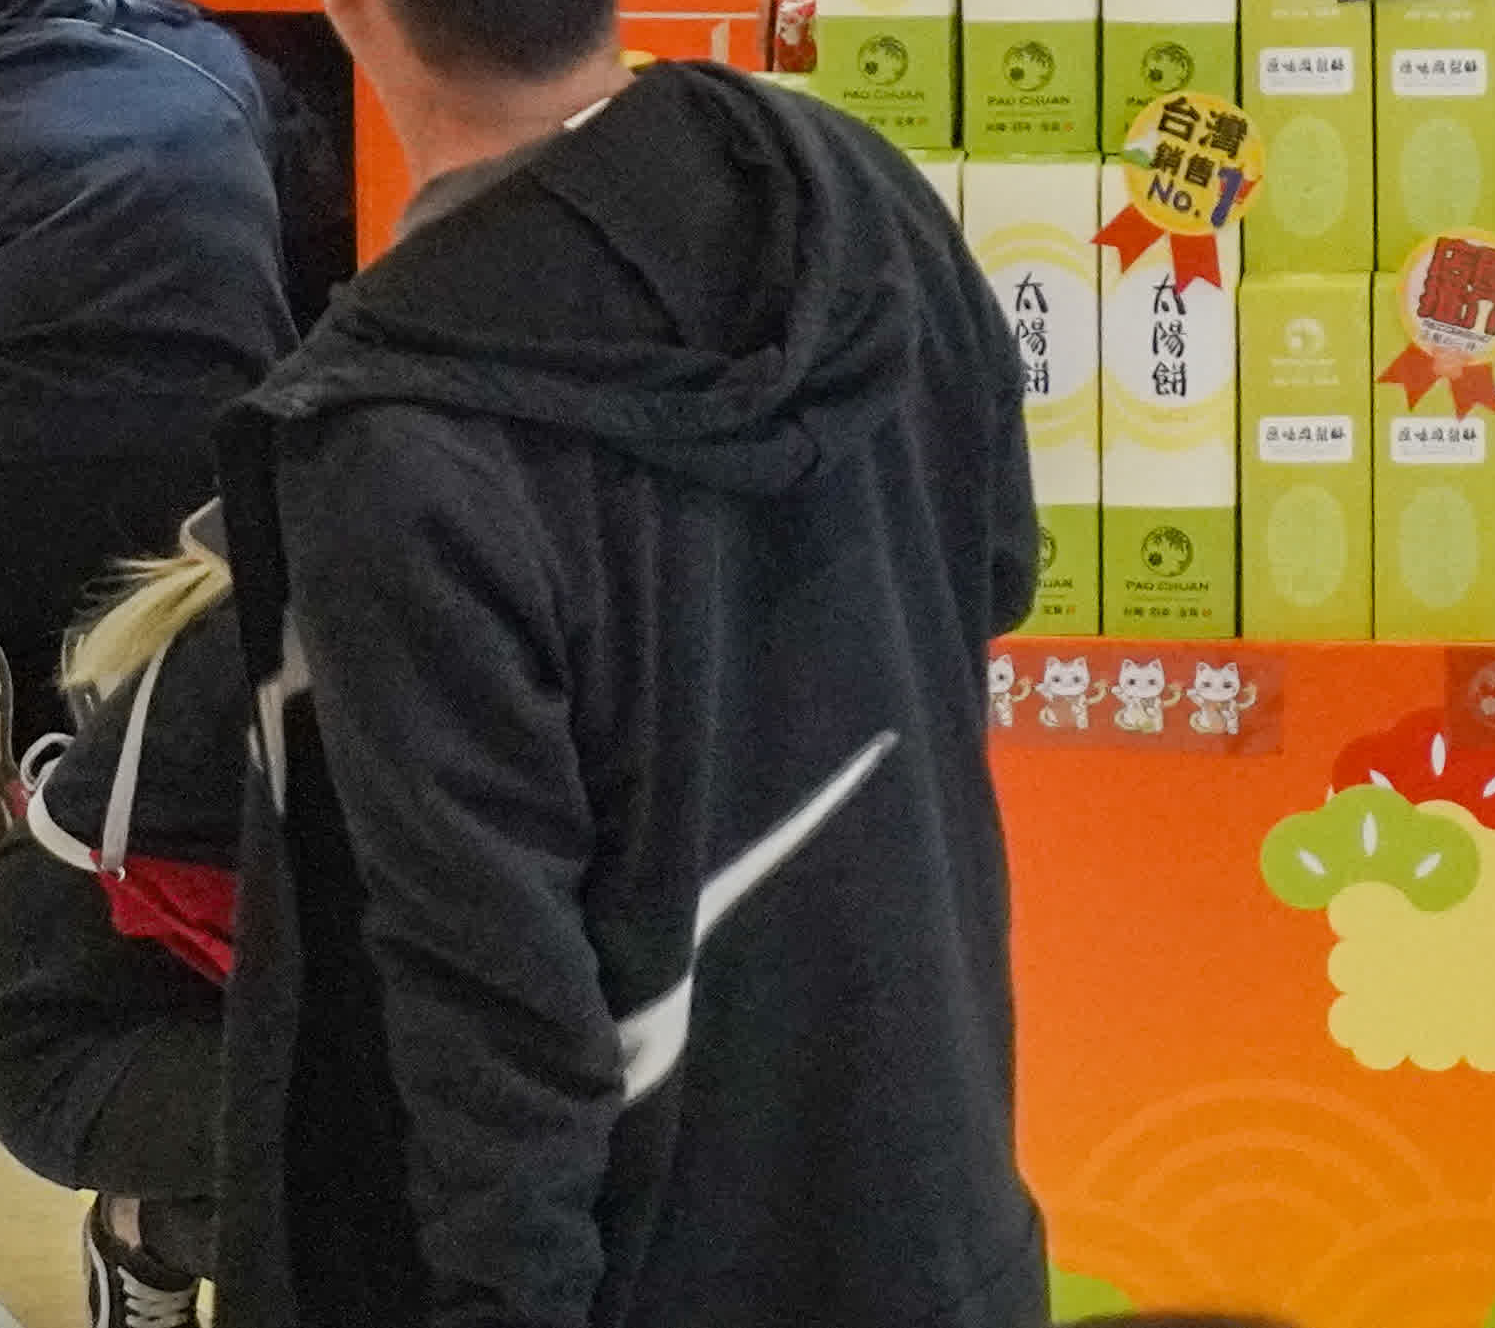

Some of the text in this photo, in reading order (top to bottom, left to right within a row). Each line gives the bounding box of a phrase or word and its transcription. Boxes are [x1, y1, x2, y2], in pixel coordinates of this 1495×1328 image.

[1155, 94, 1250, 159] 台灣
[1147, 140, 1217, 186] 銷售
[1151, 277, 1188, 400] 太陽餅
[1125, 581, 1210, 592] PAO CHUAN
